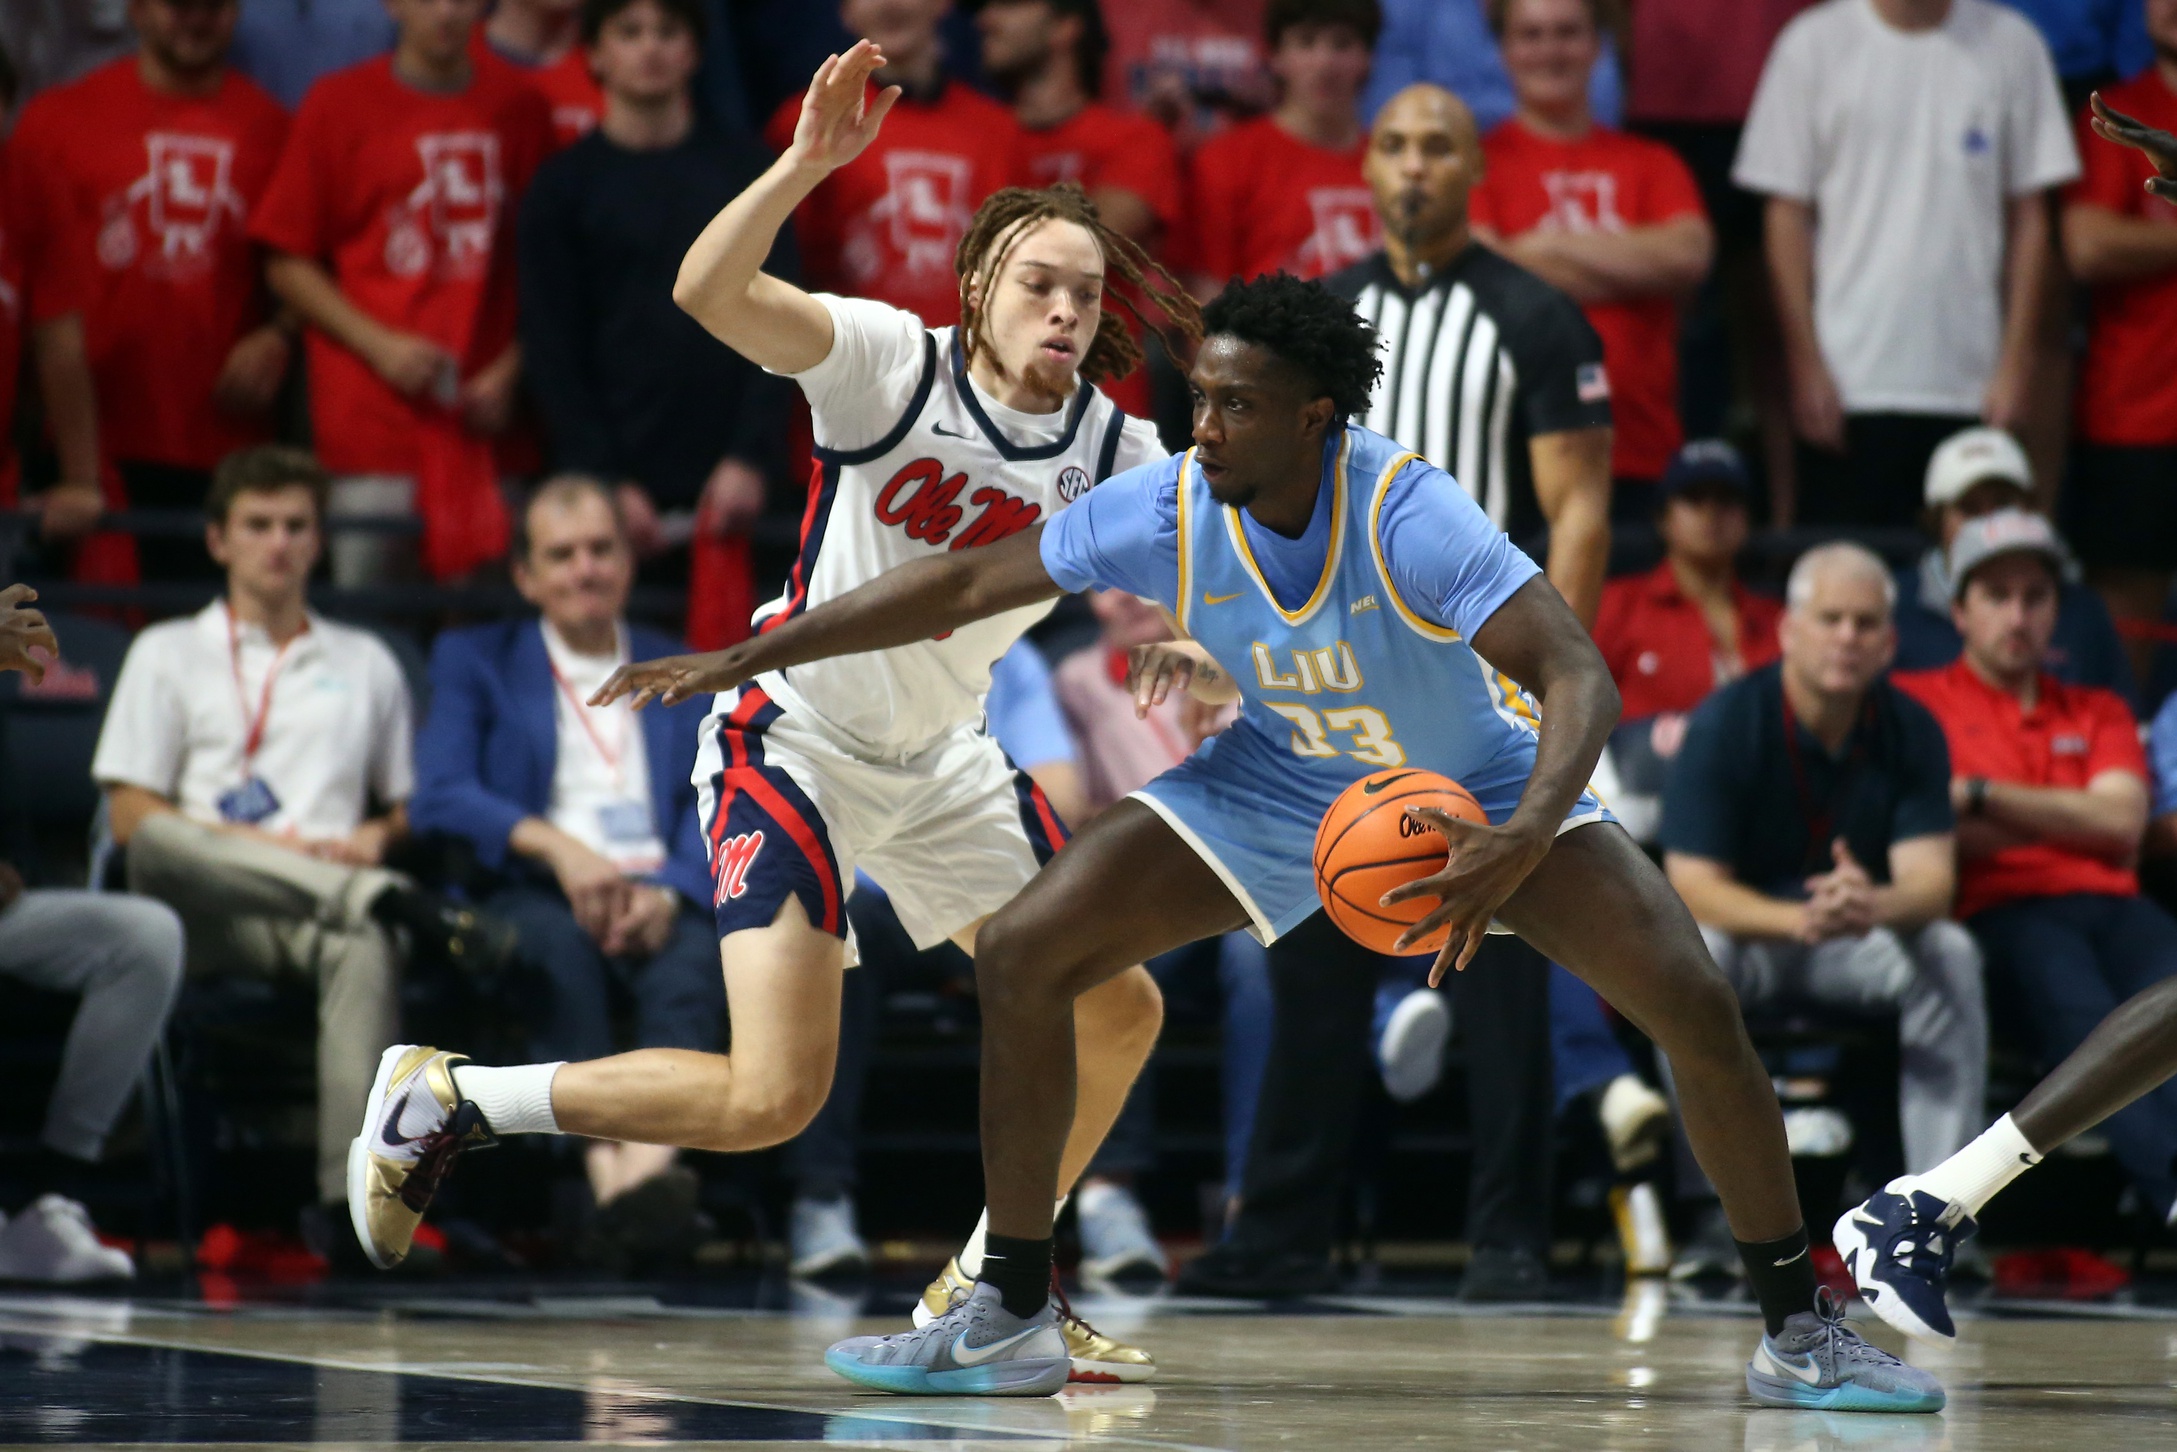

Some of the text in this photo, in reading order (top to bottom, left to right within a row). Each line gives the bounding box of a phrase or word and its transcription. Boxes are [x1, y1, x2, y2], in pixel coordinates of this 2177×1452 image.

[874, 457, 969, 546] Ole
[1059, 468, 1089, 501] SEC
[1252, 640, 1365, 695] LIU
[1261, 701, 1408, 768] 33
